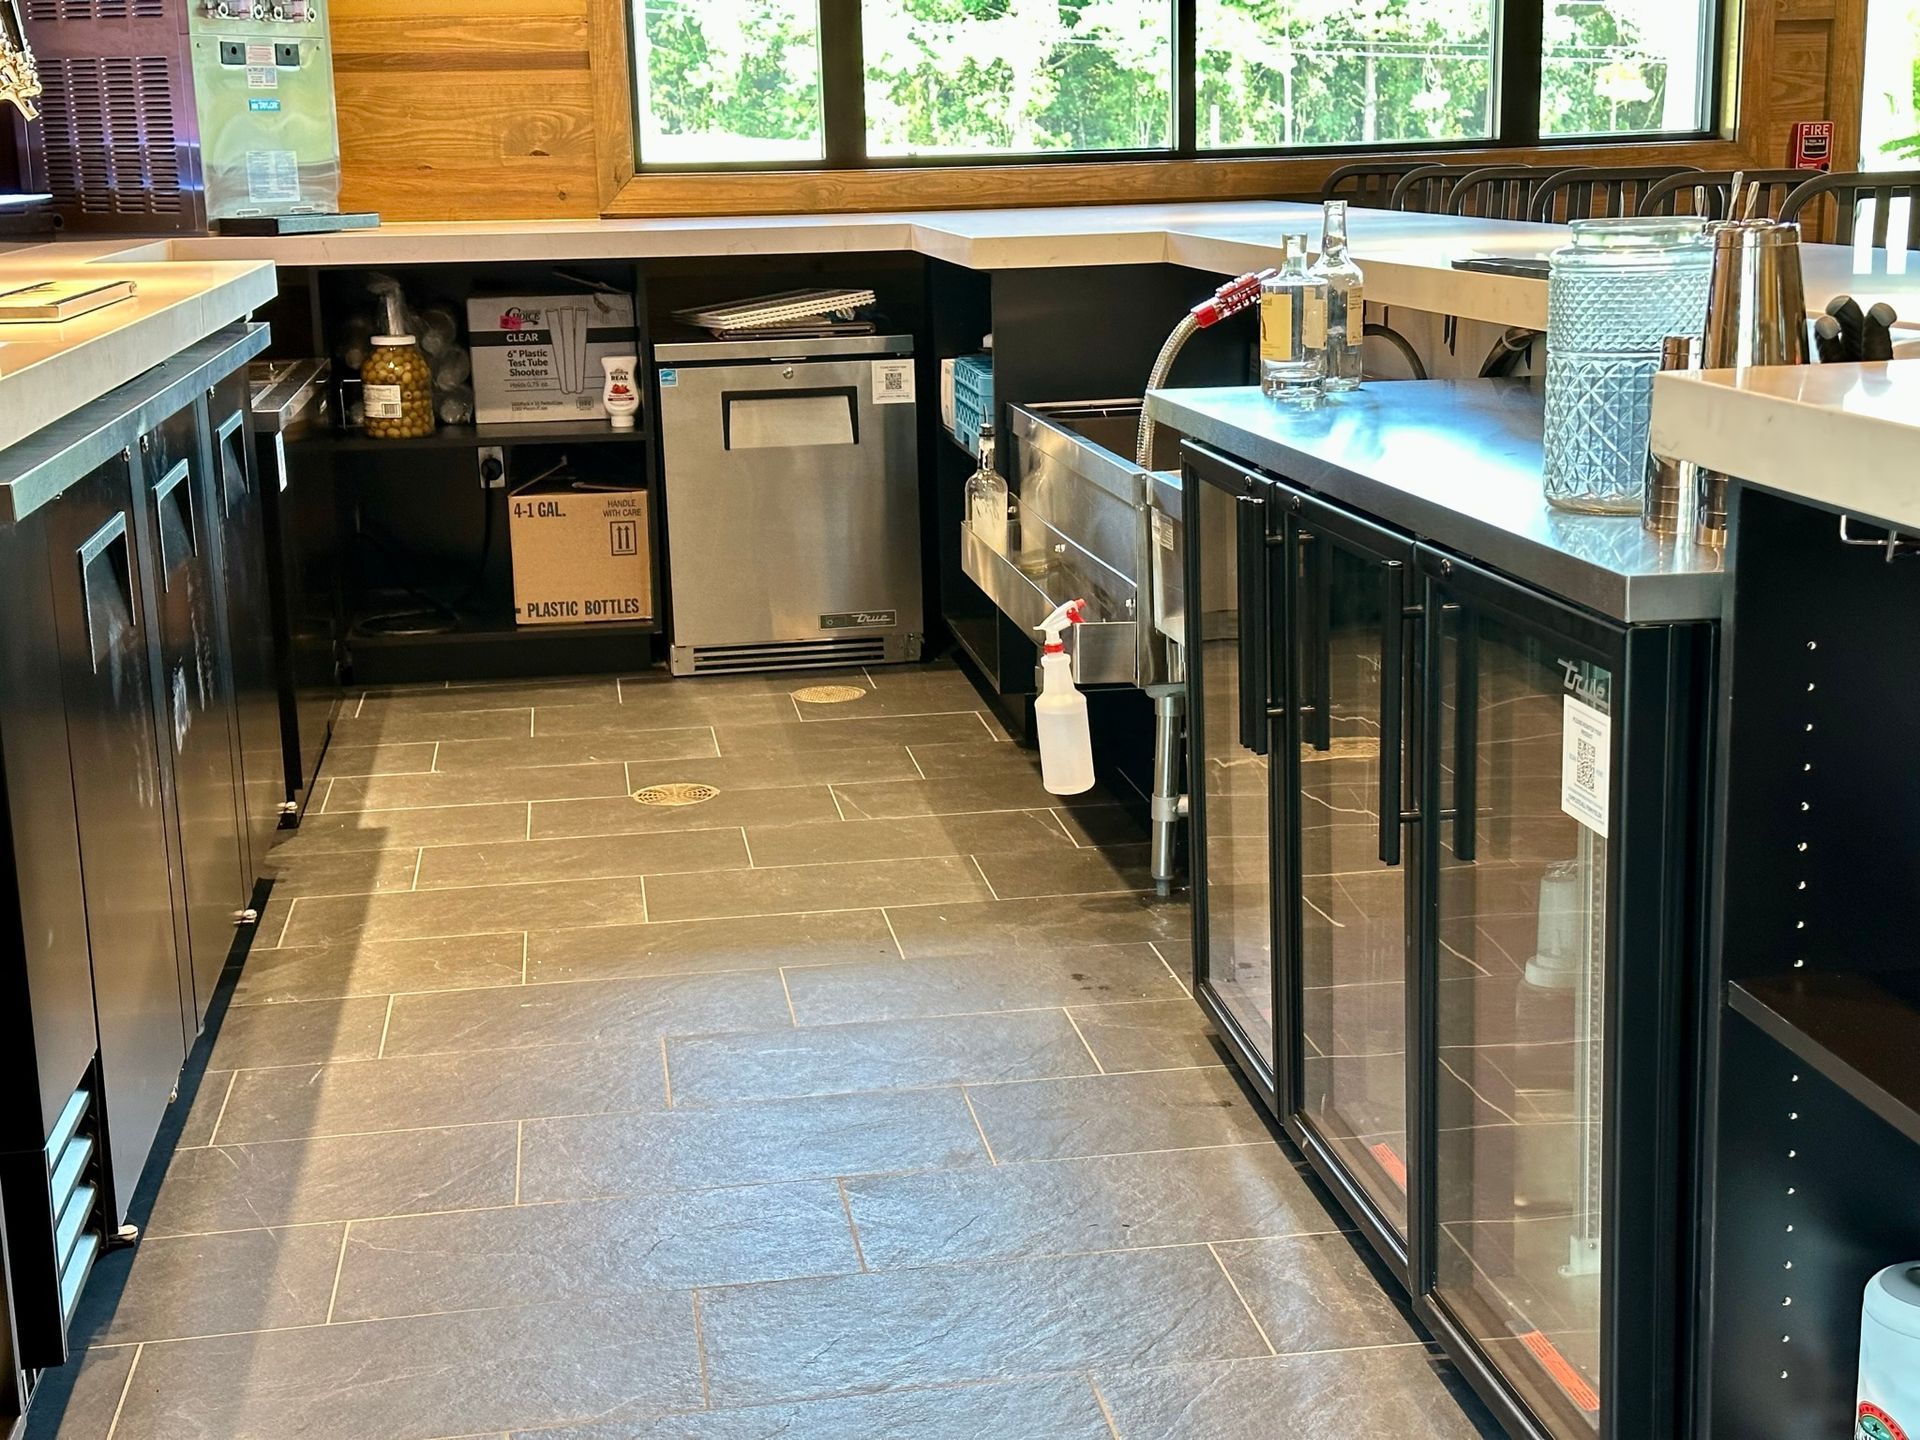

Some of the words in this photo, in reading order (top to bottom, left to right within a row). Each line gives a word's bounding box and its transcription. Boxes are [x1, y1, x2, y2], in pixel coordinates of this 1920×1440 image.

[1803, 124, 1830, 136] FIRE
[506, 333, 539, 343] CLEAR
[519, 348, 548, 358] Plastic
[507, 359, 527, 367] Test
[527, 358, 549, 367] Tube
[509, 368, 549, 377] Shooters
[607, 499, 636, 508] HANDLE
[514, 502, 534, 518] 4-1
[538, 501, 567, 518] GAL.
[602, 509, 620, 518] WITH
[622, 508, 642, 517] CARE
[527, 600, 578, 618] PLASTIC
[584, 598, 640, 616] BOTTLES
